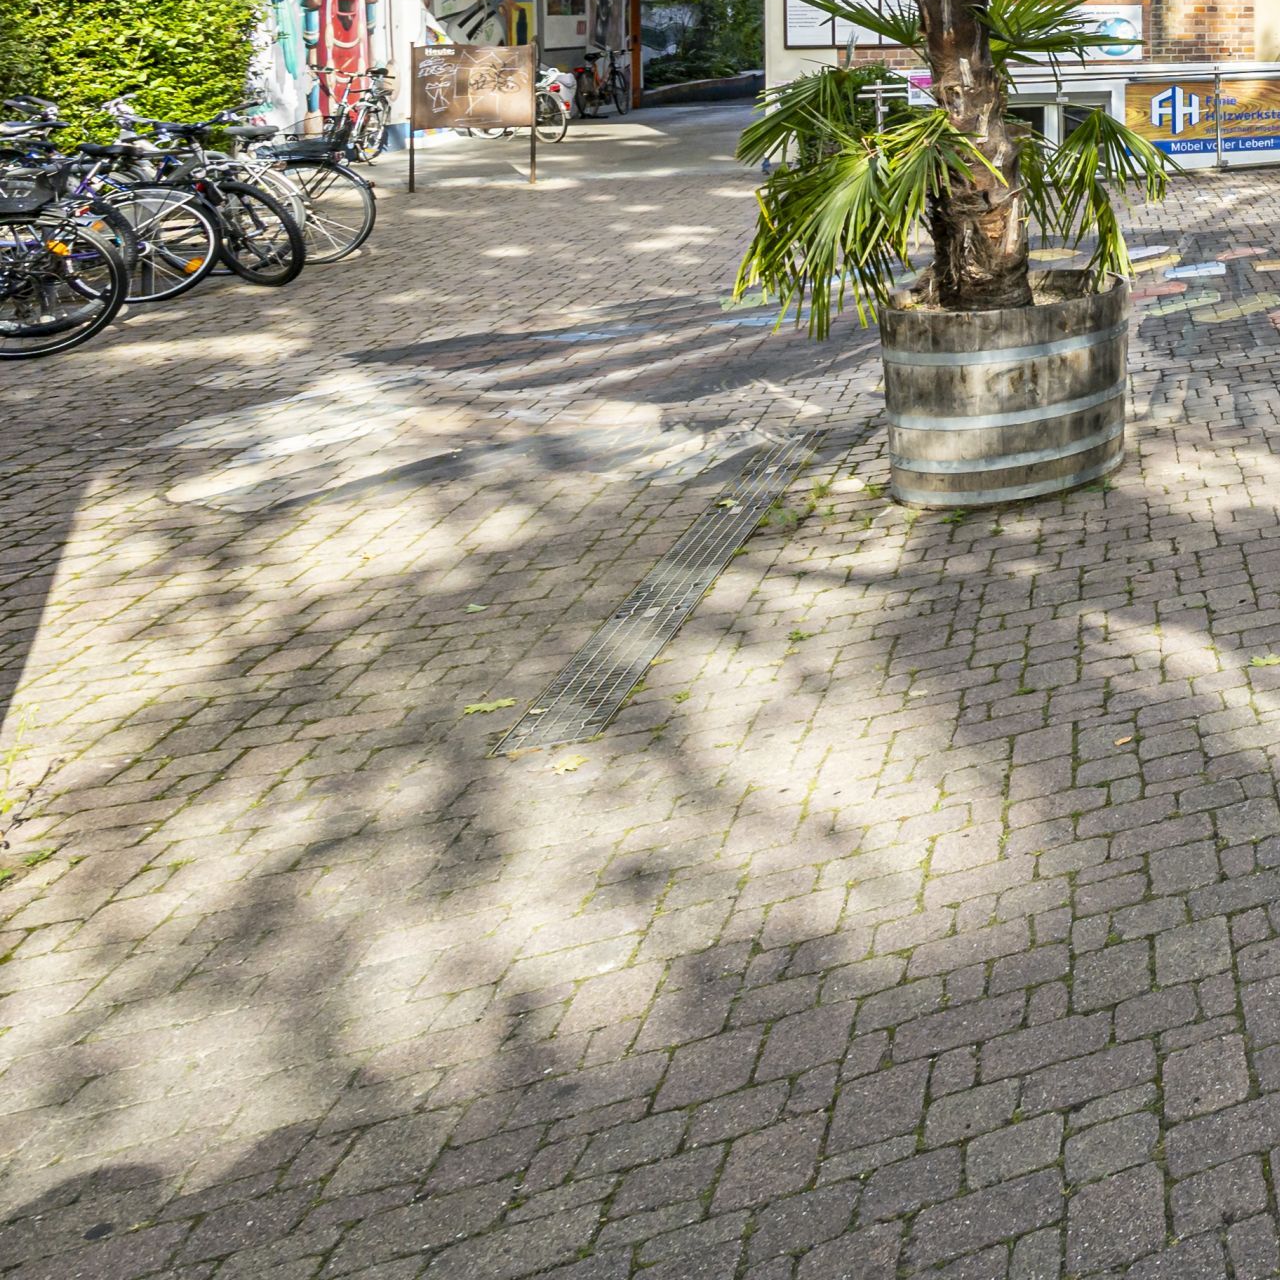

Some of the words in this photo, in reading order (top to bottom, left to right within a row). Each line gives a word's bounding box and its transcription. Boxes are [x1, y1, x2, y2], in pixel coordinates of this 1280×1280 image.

[424, 48, 455, 56] Heute:
[1171, 141, 1203, 152] Möbel
[1206, 140, 1236, 150] voler
[1239, 138, 1274, 149] Leben!
